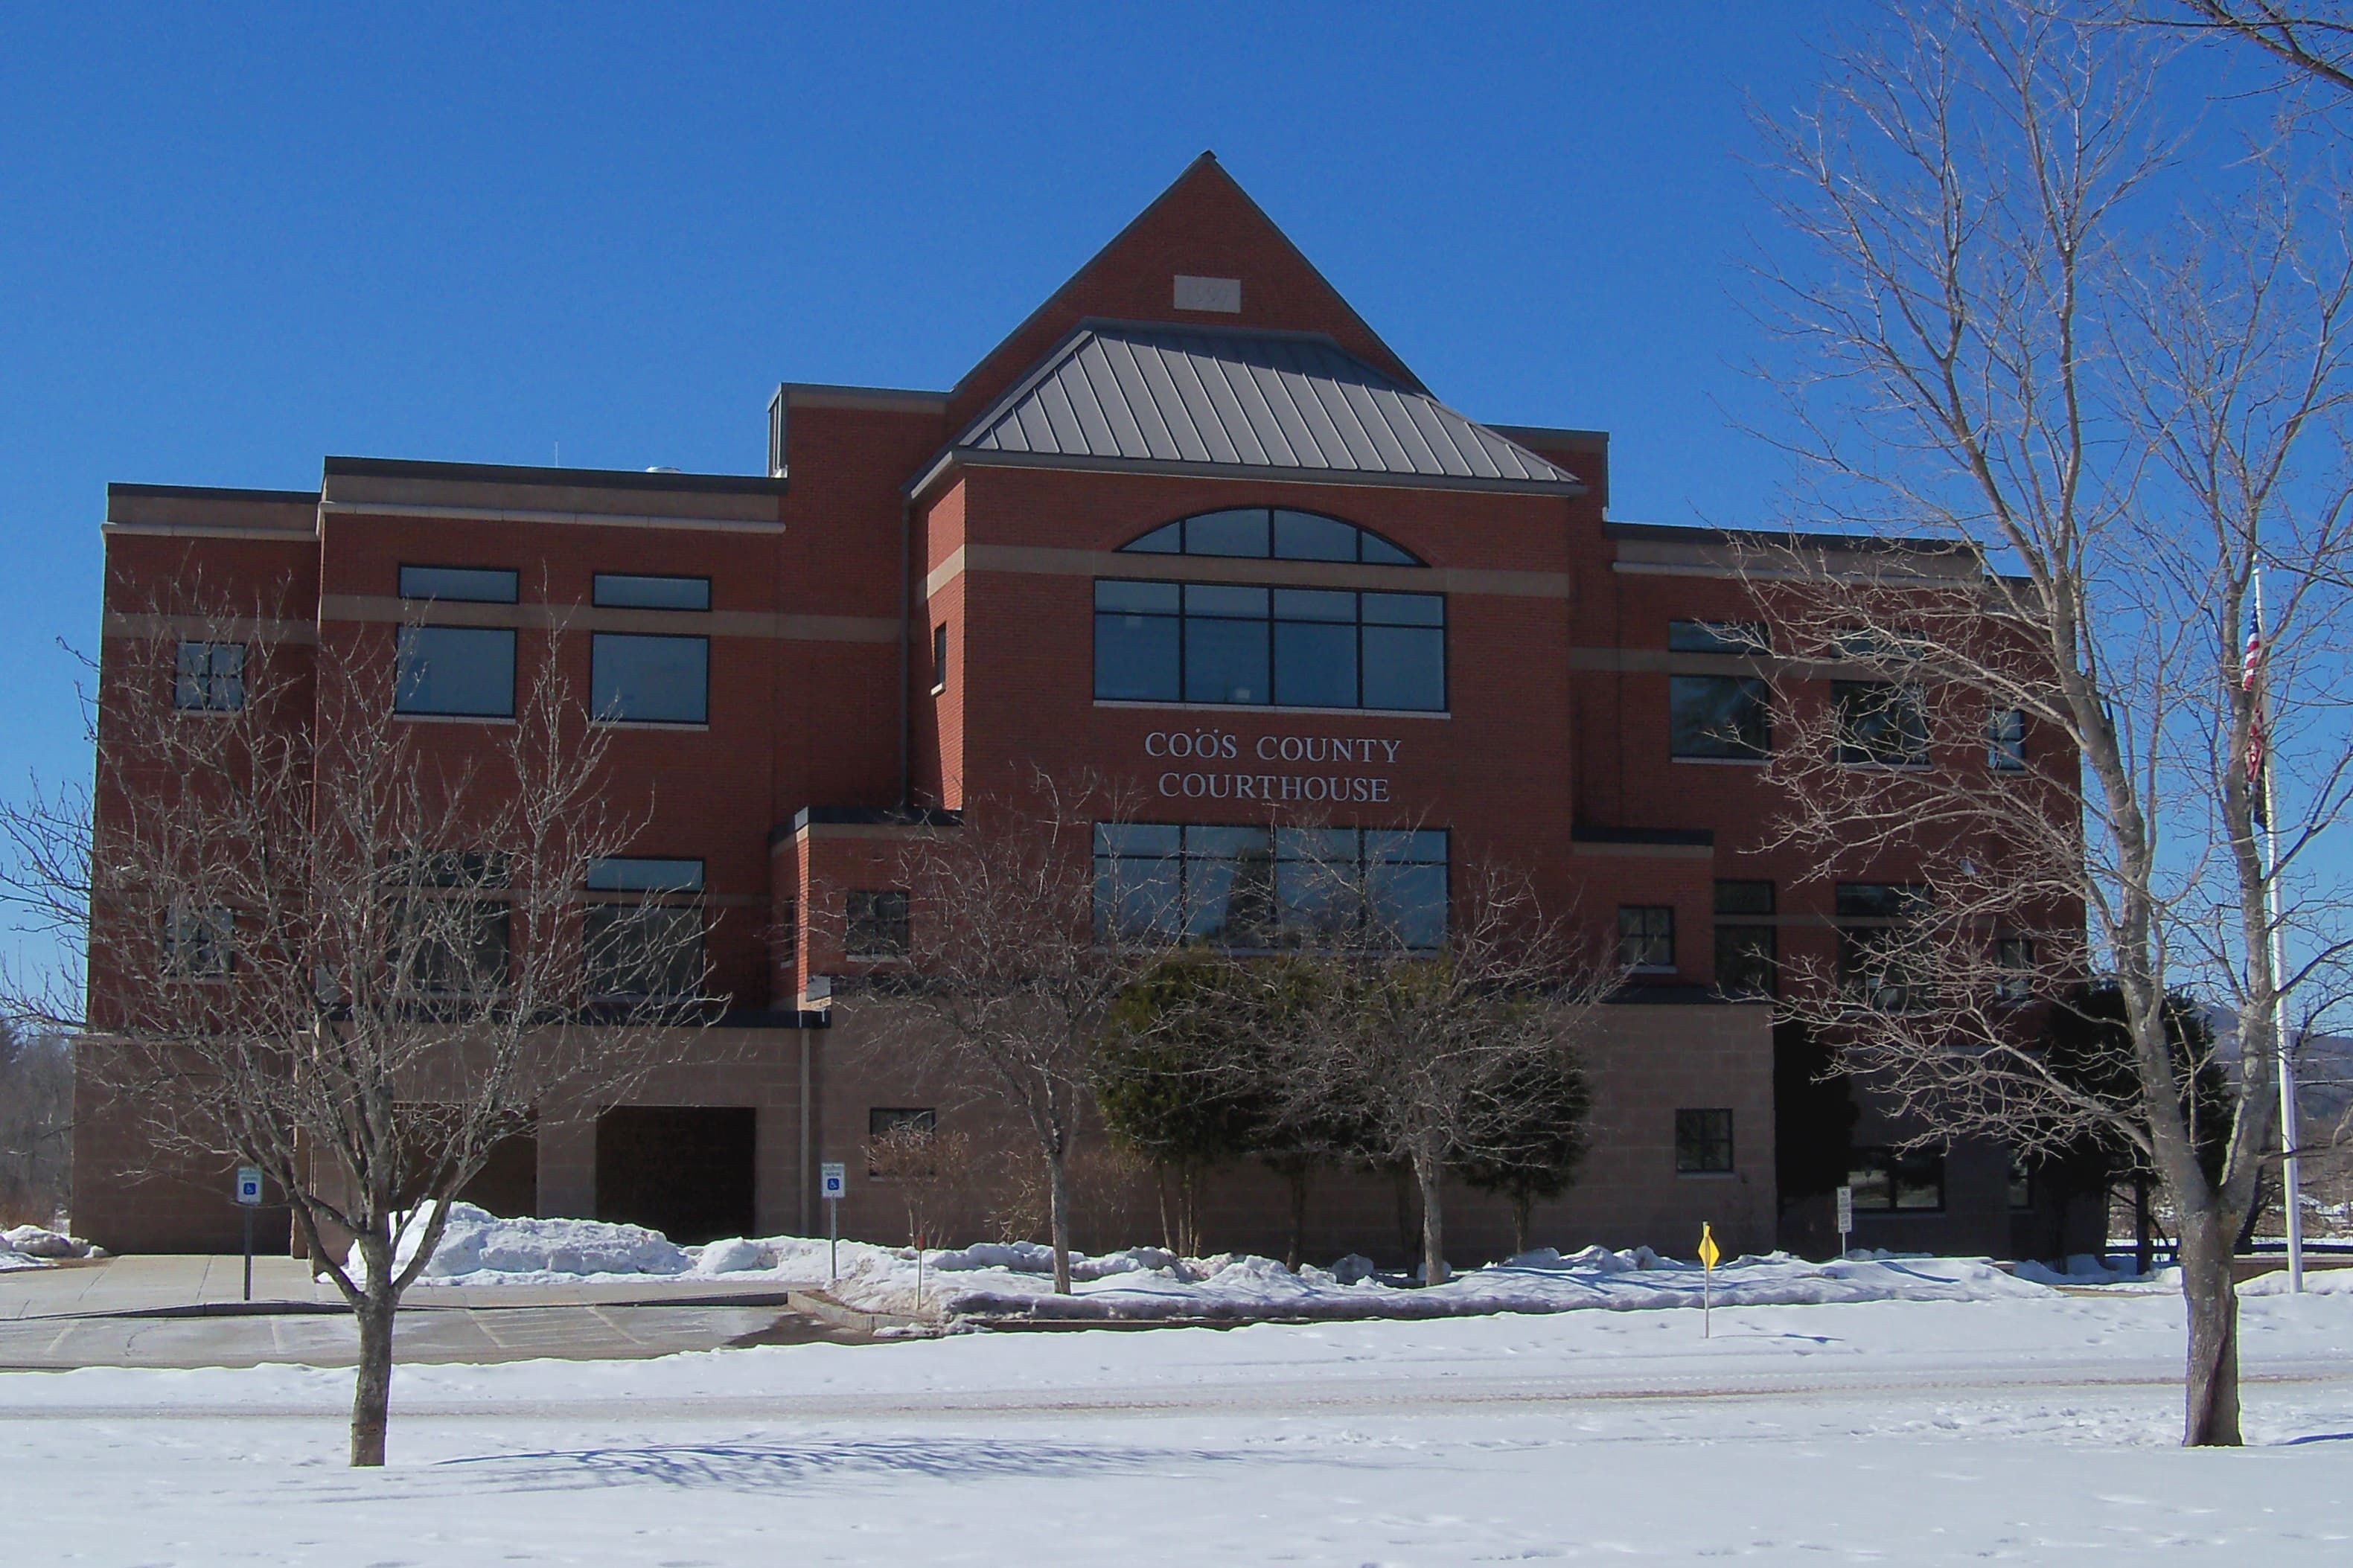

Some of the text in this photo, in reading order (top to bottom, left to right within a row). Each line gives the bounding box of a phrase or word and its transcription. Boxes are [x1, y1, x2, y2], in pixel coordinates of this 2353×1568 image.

[1145, 728, 1402, 763] COÖS COUNTY
[1158, 772, 1390, 802] COURTHOUSE
